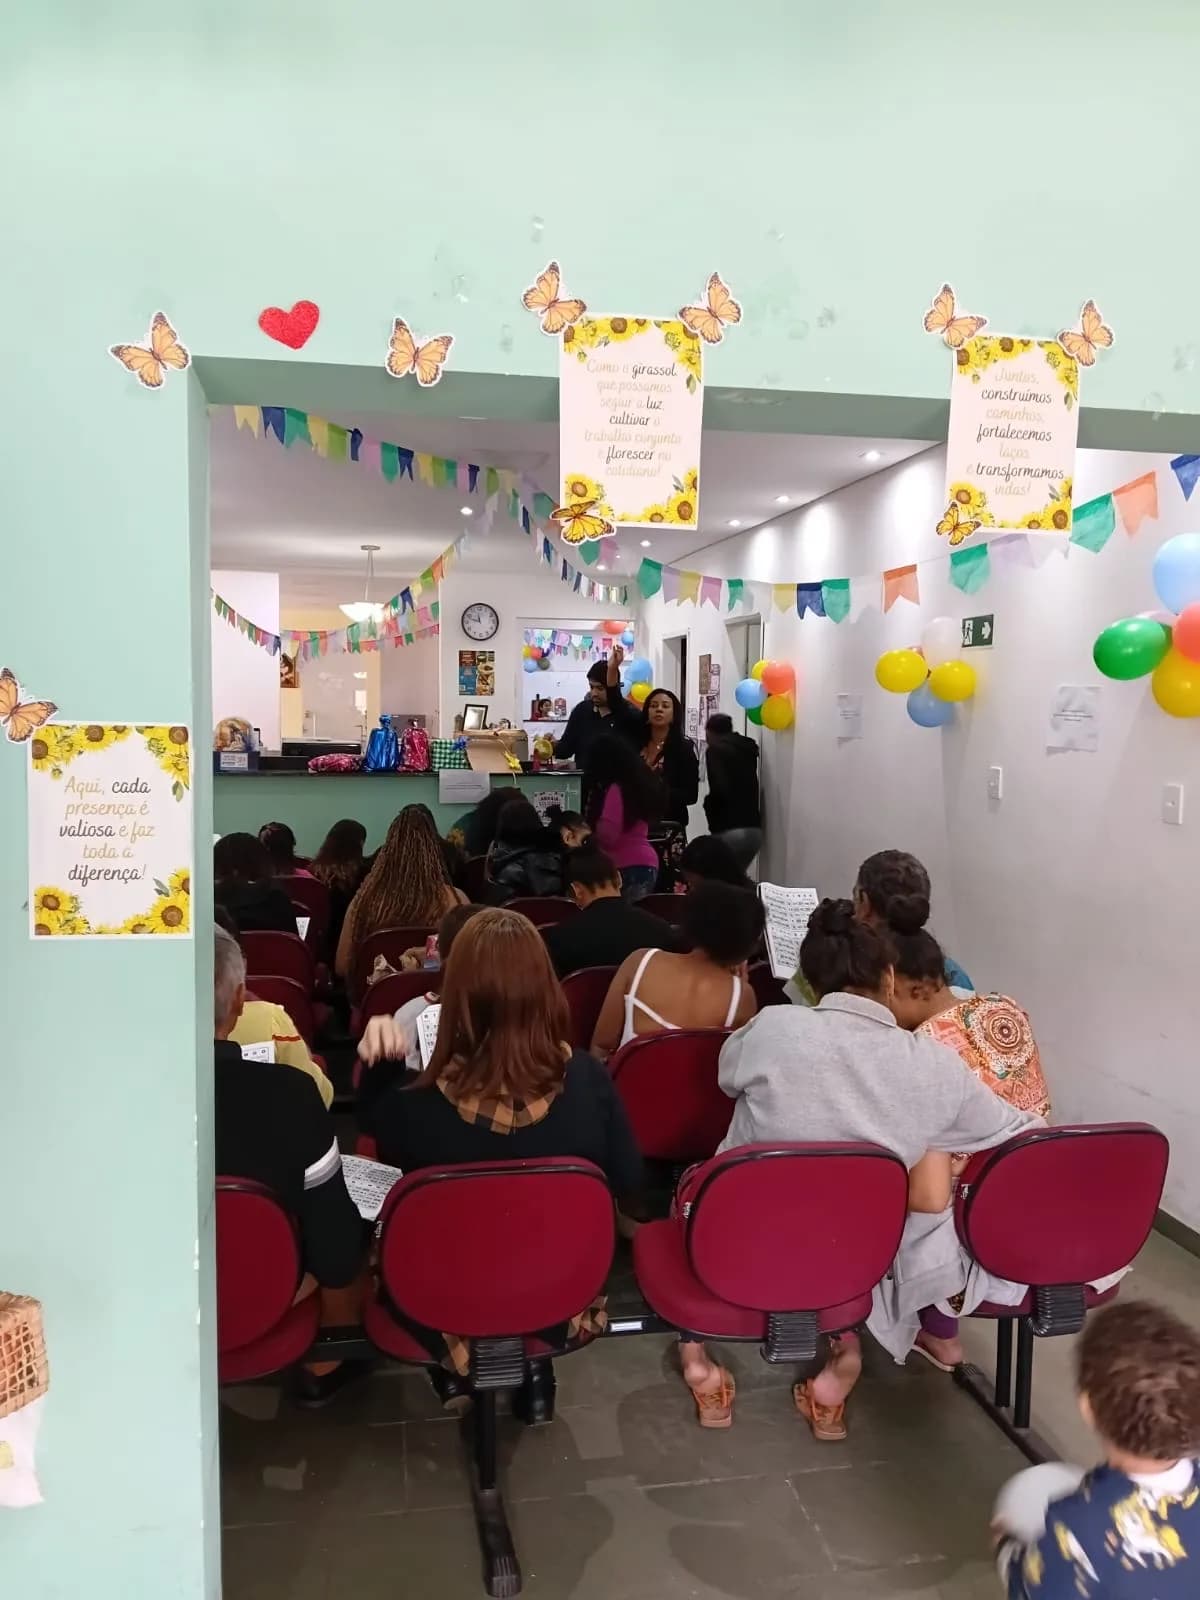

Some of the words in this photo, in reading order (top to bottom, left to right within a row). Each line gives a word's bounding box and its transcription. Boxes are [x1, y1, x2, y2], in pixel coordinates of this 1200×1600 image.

[586, 358, 619, 374] Como
[631, 362, 678, 379] girassol,
[597, 380, 617, 393] que
[618, 381, 672, 393] possamos
[600, 397, 632, 413] seguir
[609, 412, 651, 426] cultivar
[584, 429, 632, 442] trabalho
[634, 432, 682, 449] conjunto
[976, 423, 1052, 443] fortalecemos
[606, 444, 654, 464] florescer
[605, 465, 660, 478] cotidiano!
[976, 463, 1064, 481] transformamos
[995, 483, 1031, 496] vidas!
[64, 775, 105, 800] Aqui,
[111, 777, 151, 794] cada
[65, 802, 135, 820] presença
[139, 800, 149, 816] é
[59, 819, 115, 837] valiosa
[118, 824, 129, 837] e
[130, 822, 155, 844] faz
[83, 843, 119, 859] toda
[122, 848, 134, 859] a
[68, 863, 147, 887] diferença!
